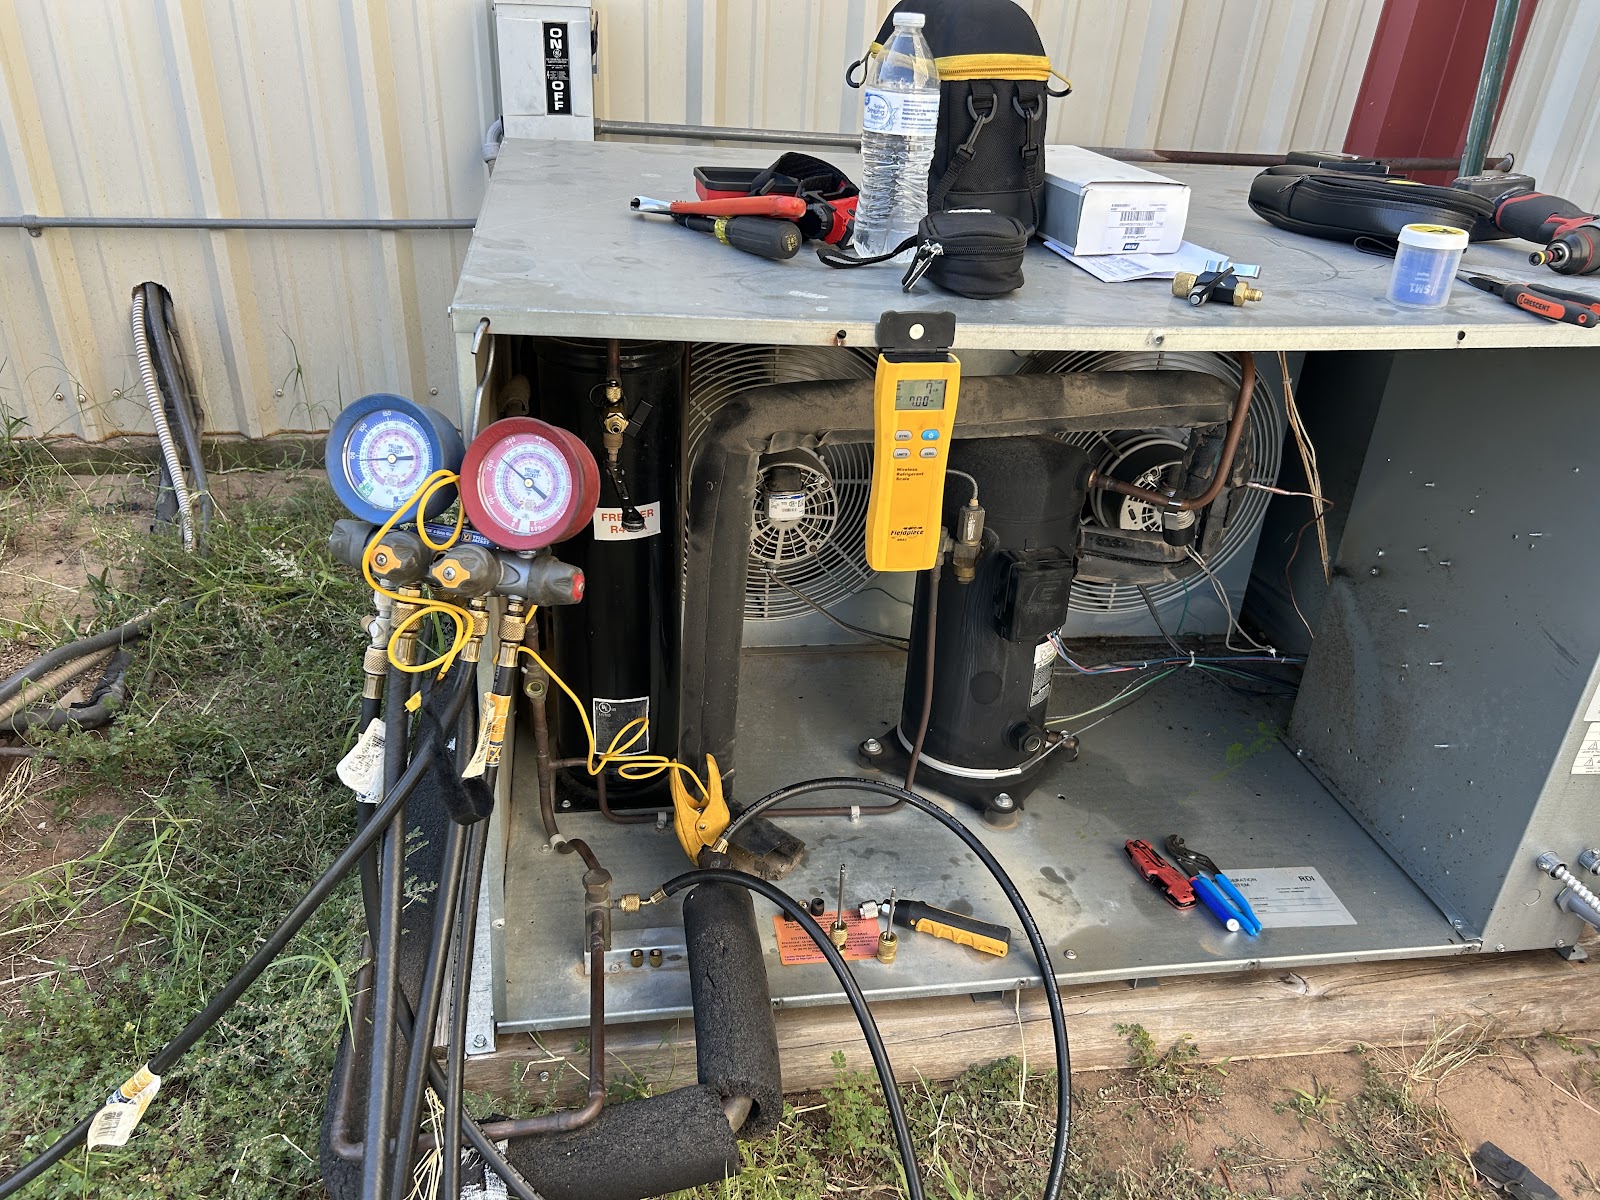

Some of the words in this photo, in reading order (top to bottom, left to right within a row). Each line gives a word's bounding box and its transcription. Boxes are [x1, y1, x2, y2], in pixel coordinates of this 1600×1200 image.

[550, 28, 562, 49] ON
[552, 81, 564, 110] OFF
[1523, 298, 1550, 311] CRESCENT
[359, 423, 368, 432] 100
[505, 437, 516, 446] 300
[487, 494, 495, 505] 100
[601, 509, 654, 522] FREER
